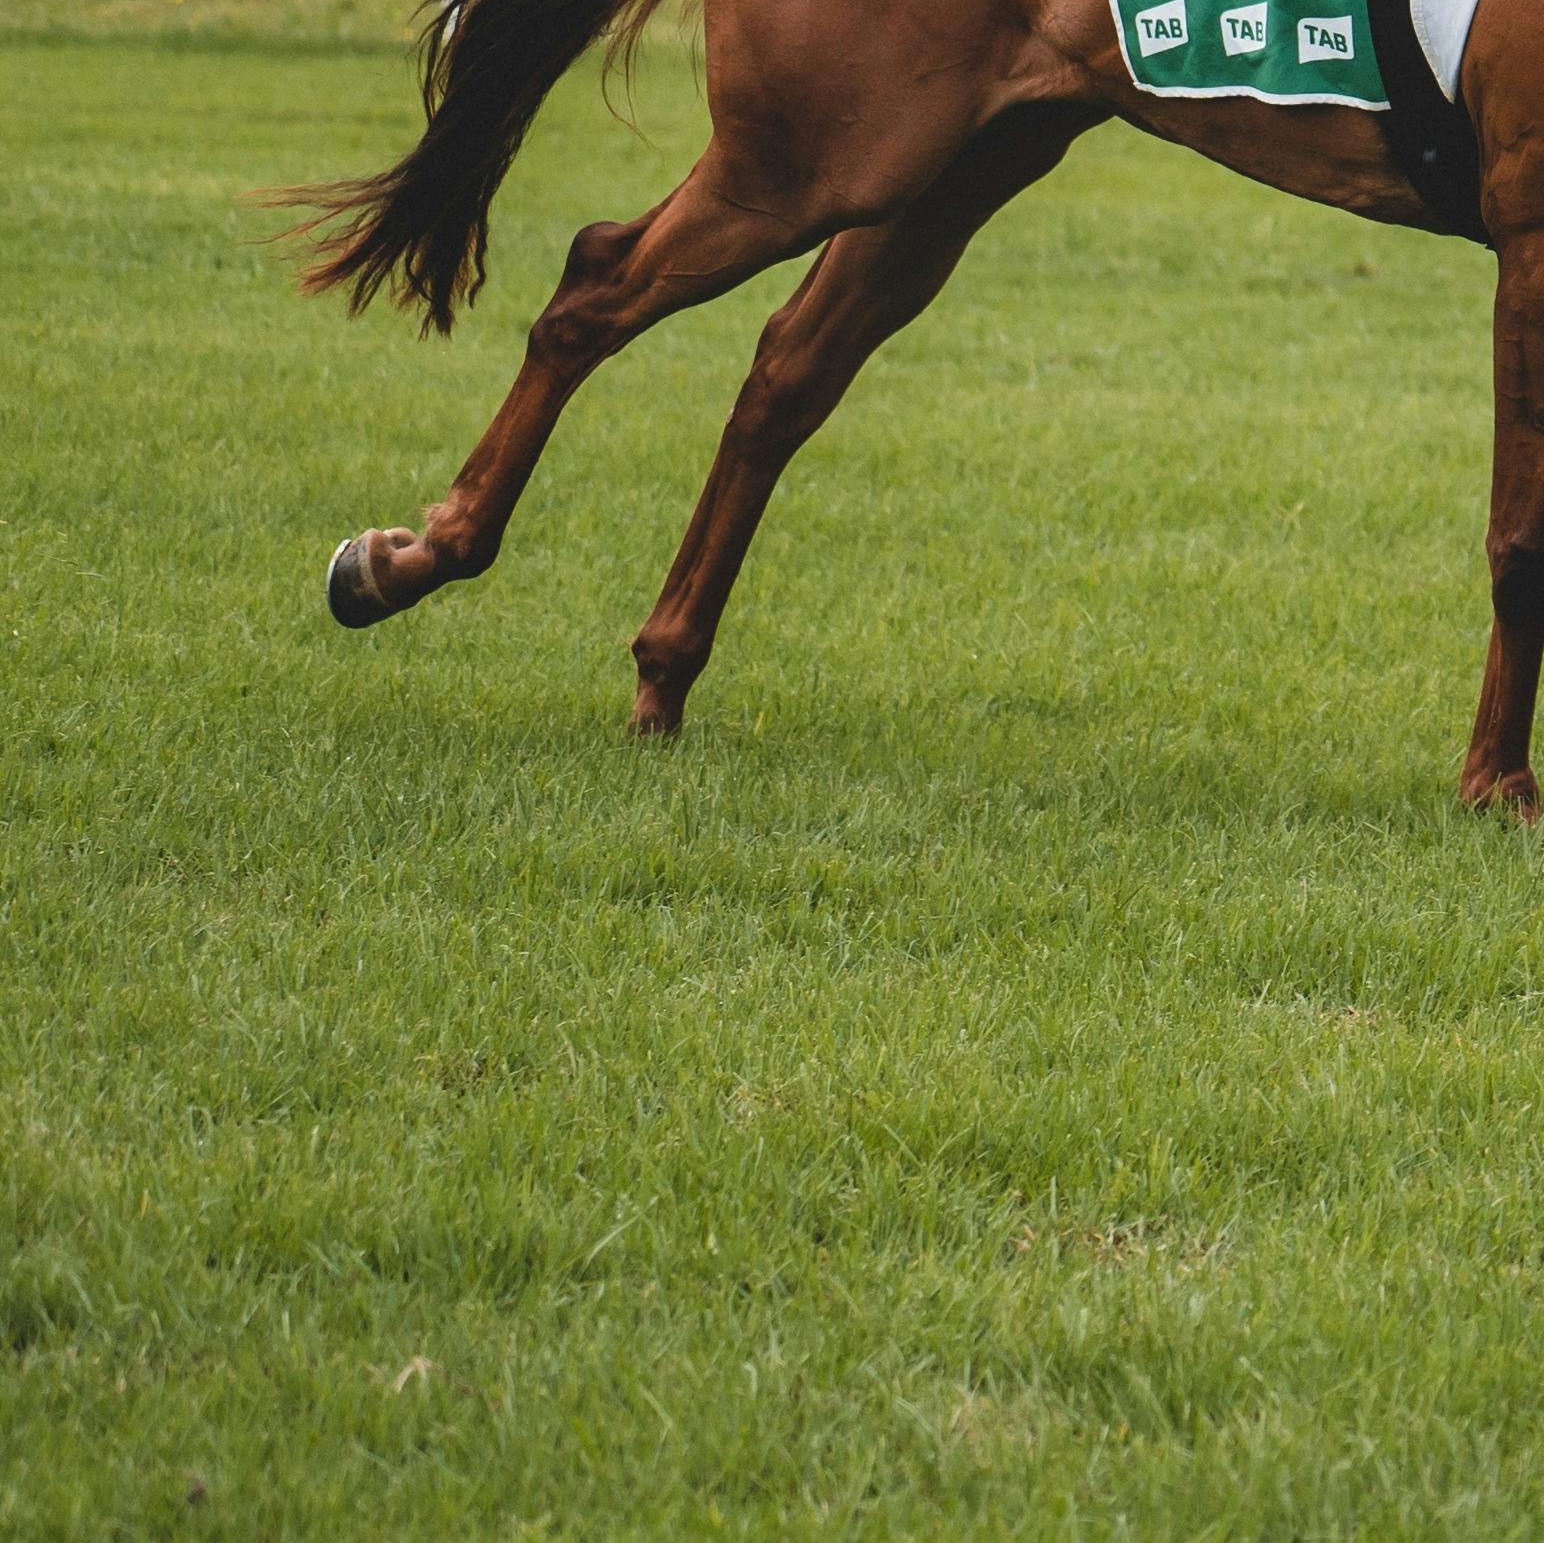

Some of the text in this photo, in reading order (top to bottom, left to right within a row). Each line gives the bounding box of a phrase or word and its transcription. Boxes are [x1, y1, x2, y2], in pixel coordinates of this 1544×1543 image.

[1140, 18, 1183, 39] TAB
[1226, 18, 1264, 42] TAB
[1304, 25, 1348, 54] TAB
